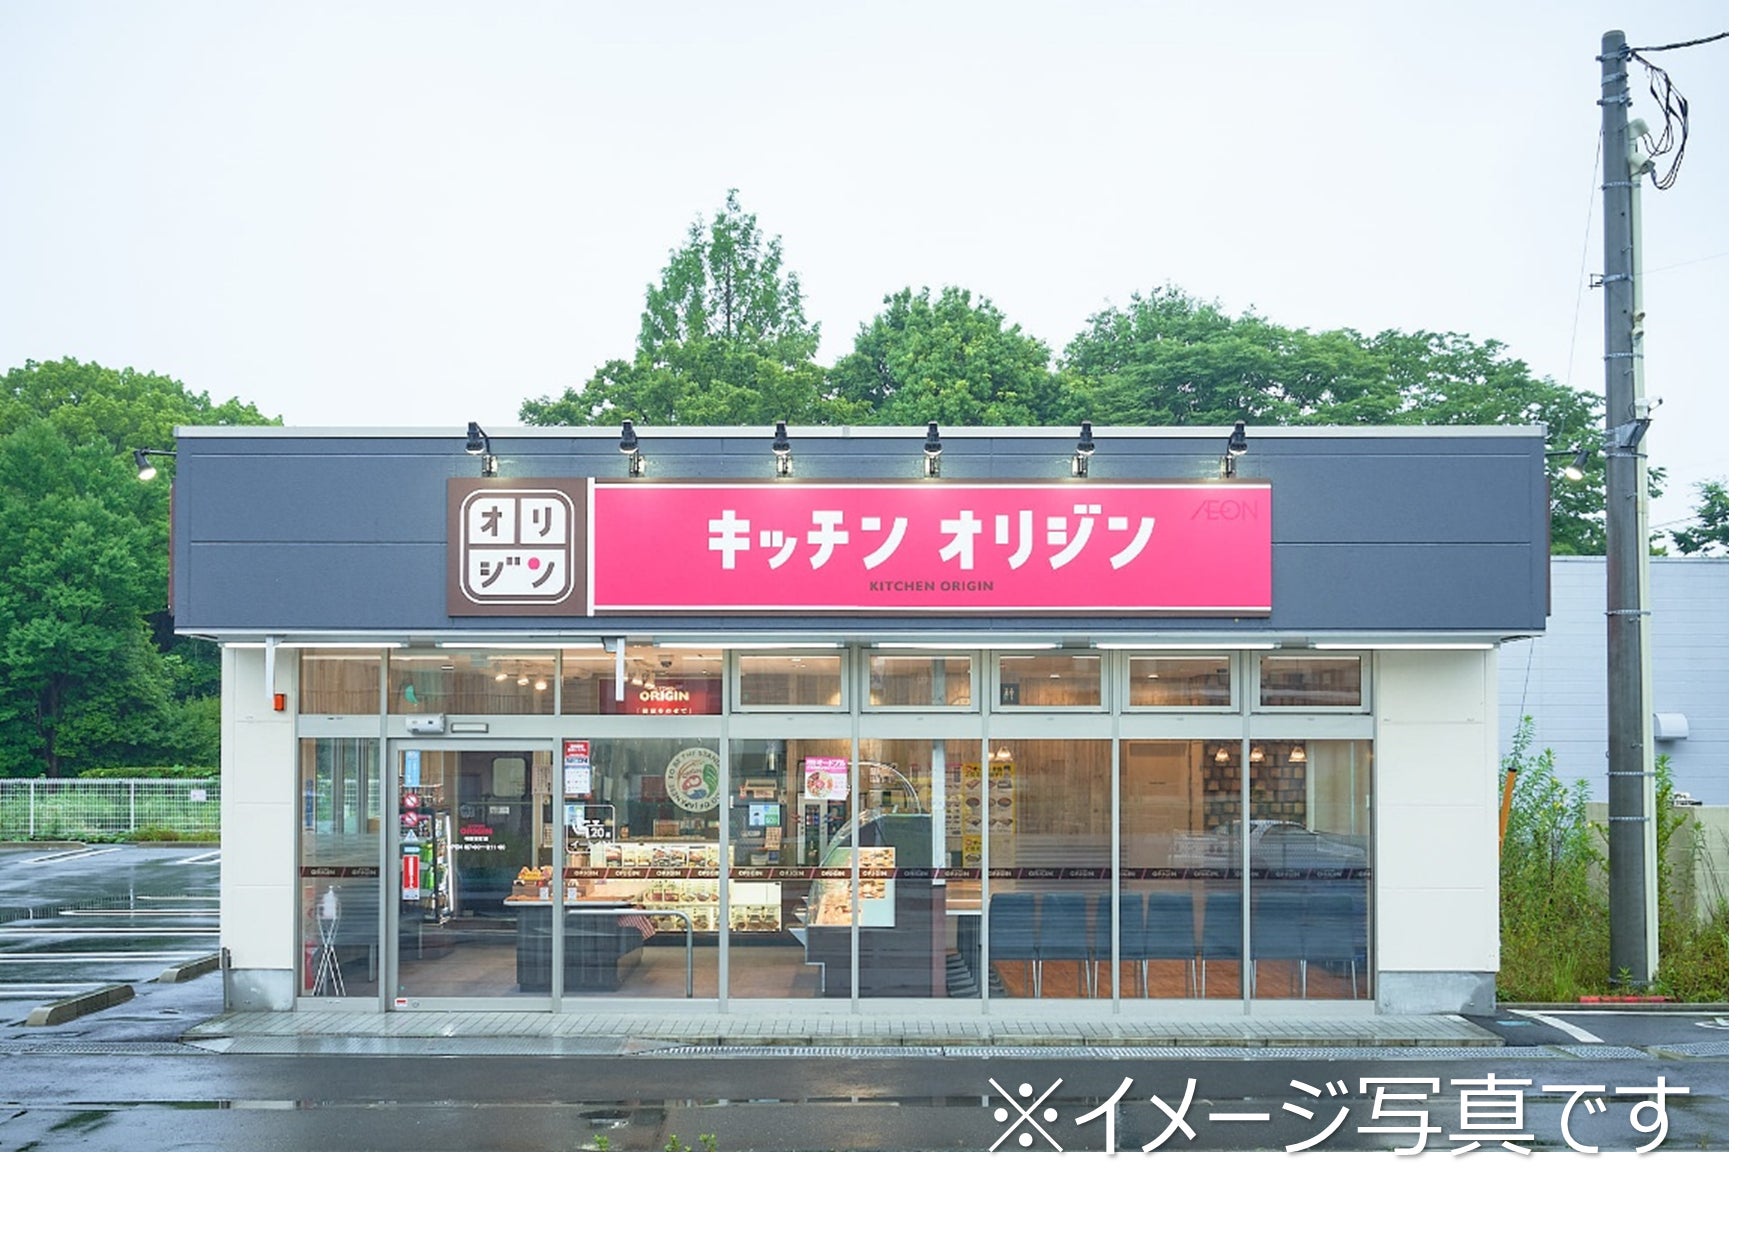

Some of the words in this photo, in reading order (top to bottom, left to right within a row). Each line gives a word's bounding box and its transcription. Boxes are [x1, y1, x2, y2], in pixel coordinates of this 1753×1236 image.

[708, 509, 908, 571] キッチン
[938, 504, 1156, 571] オリジン
[869, 580, 935, 592] KITCHEN
[940, 580, 994, 592] ORIGIN
[639, 690, 690, 701] ORIGIN
